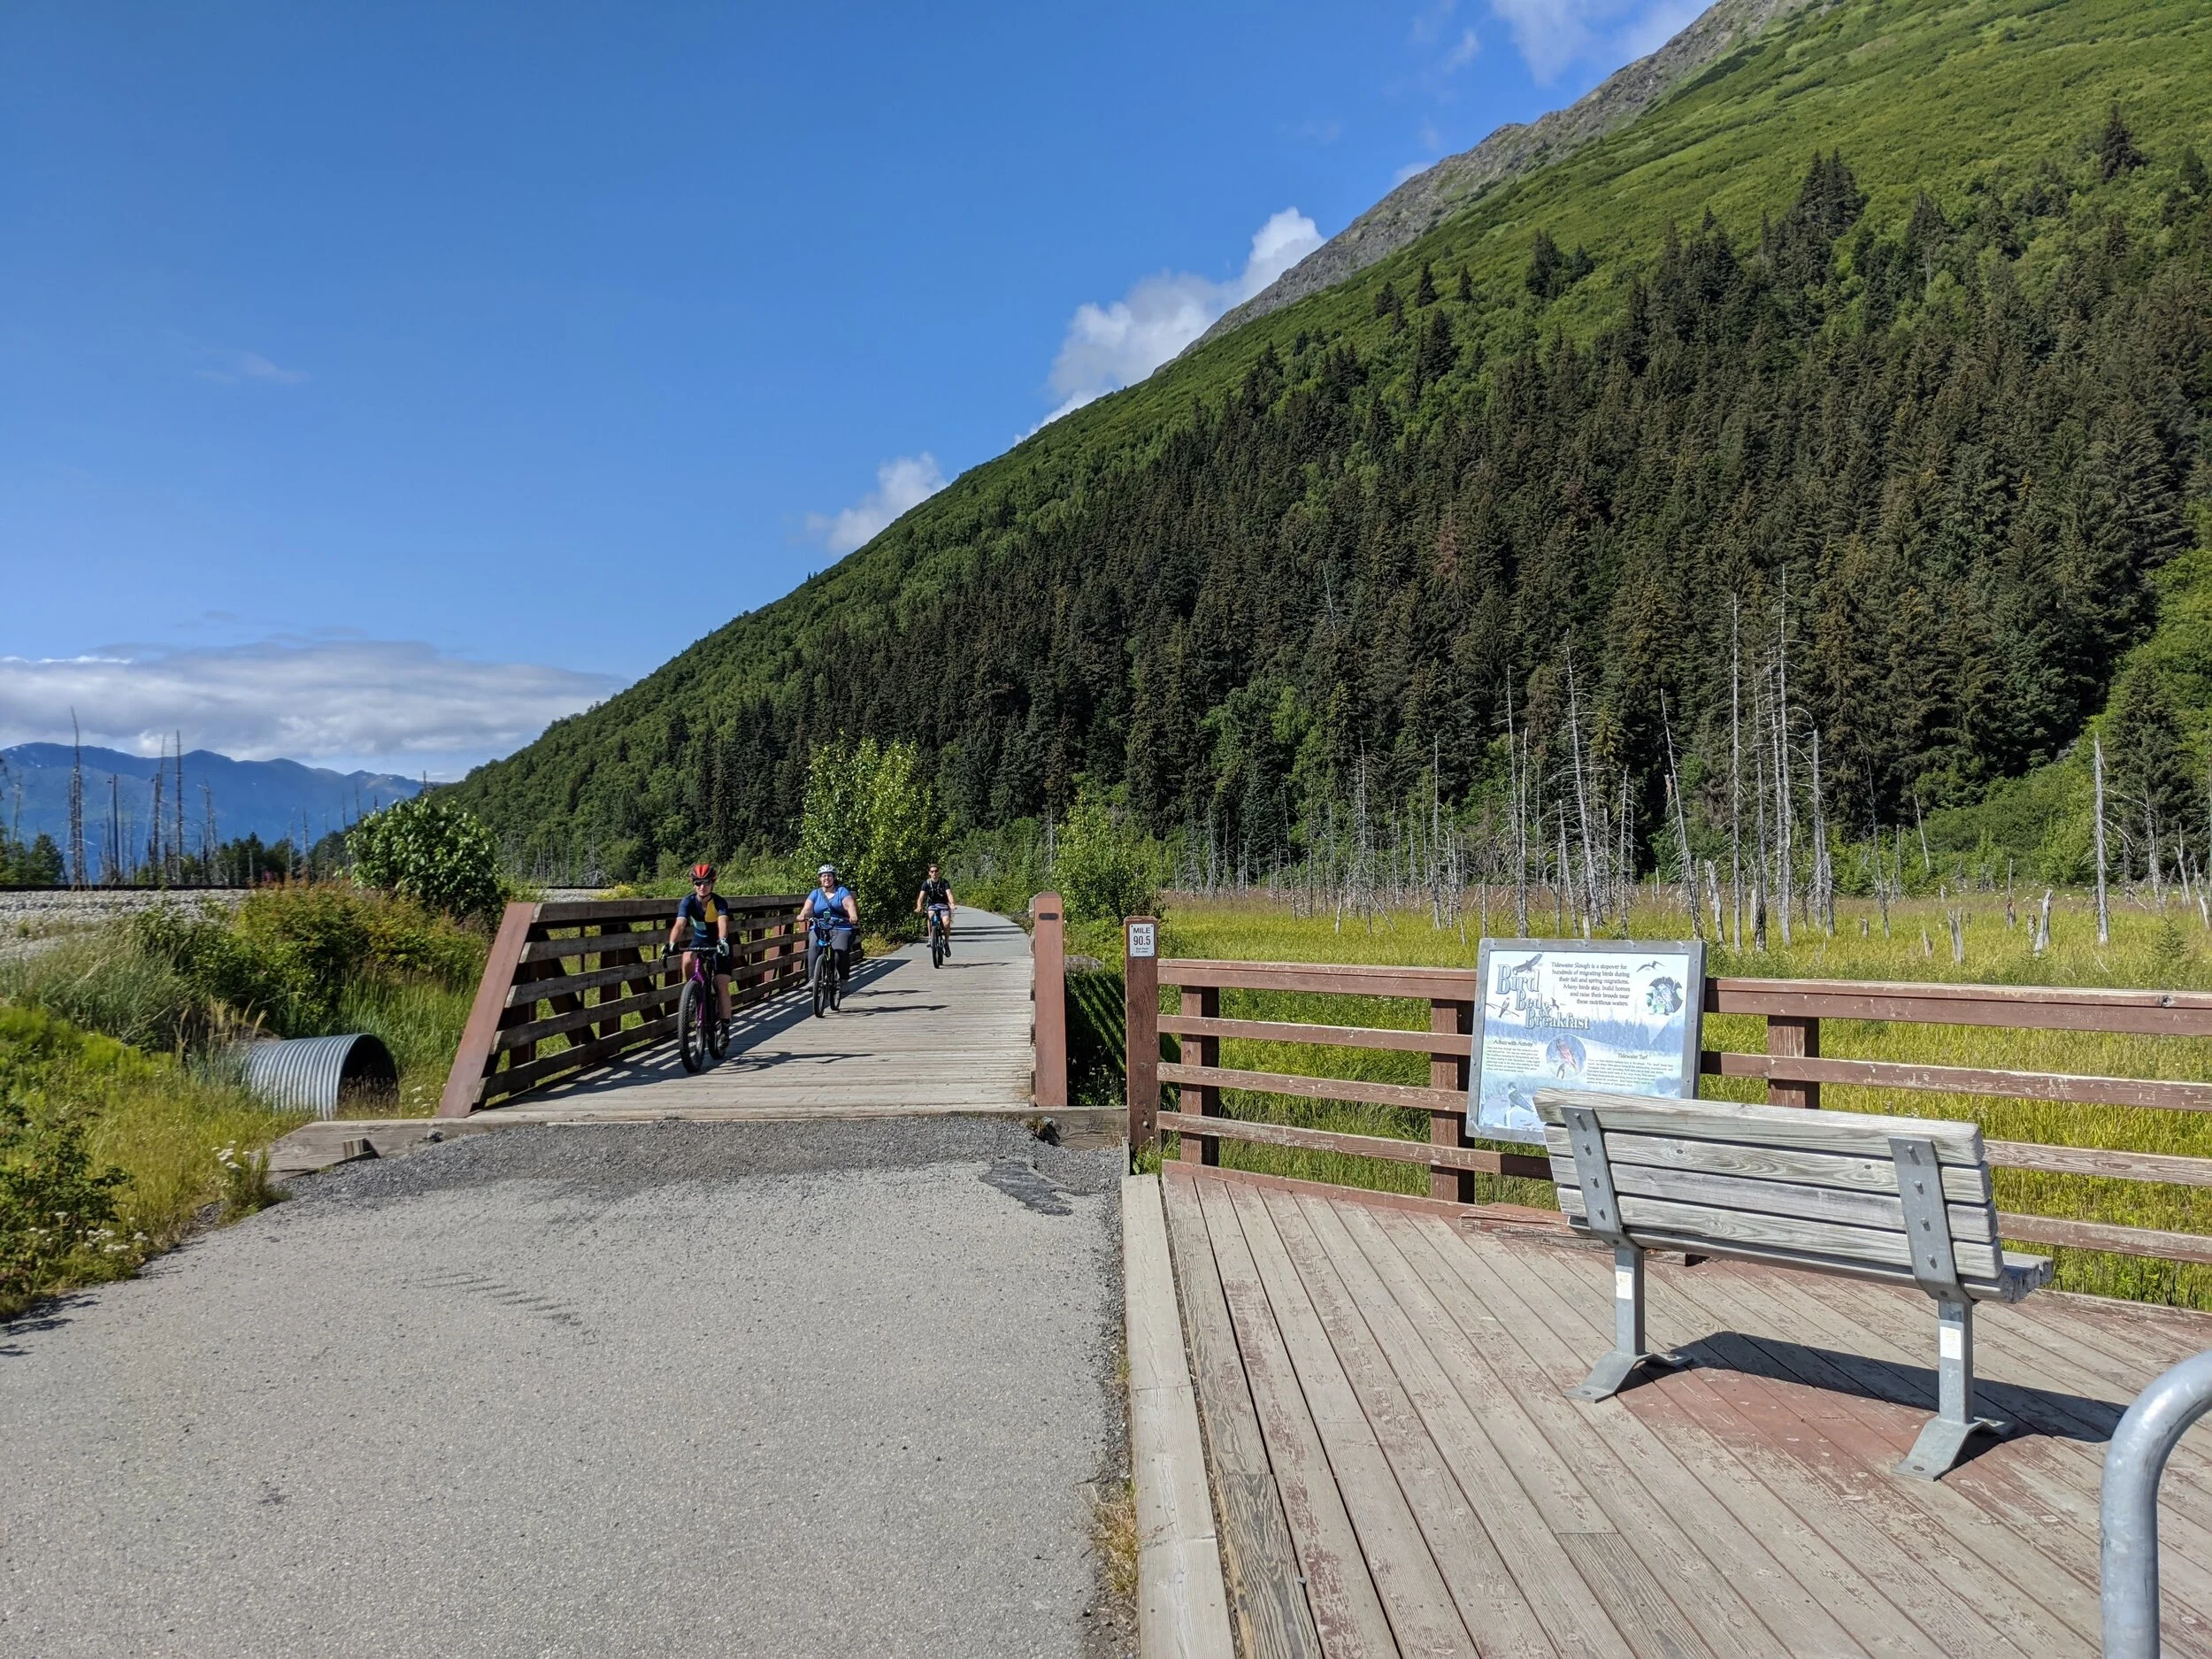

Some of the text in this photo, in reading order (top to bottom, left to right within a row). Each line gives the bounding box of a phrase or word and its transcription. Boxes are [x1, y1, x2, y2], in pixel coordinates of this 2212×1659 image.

[1133, 936, 1150, 945] 90.5
[1496, 964, 1540, 995] Bird
[1515, 988, 1552, 1018] Bed &
[1525, 1008, 1590, 1029] Breakfast
